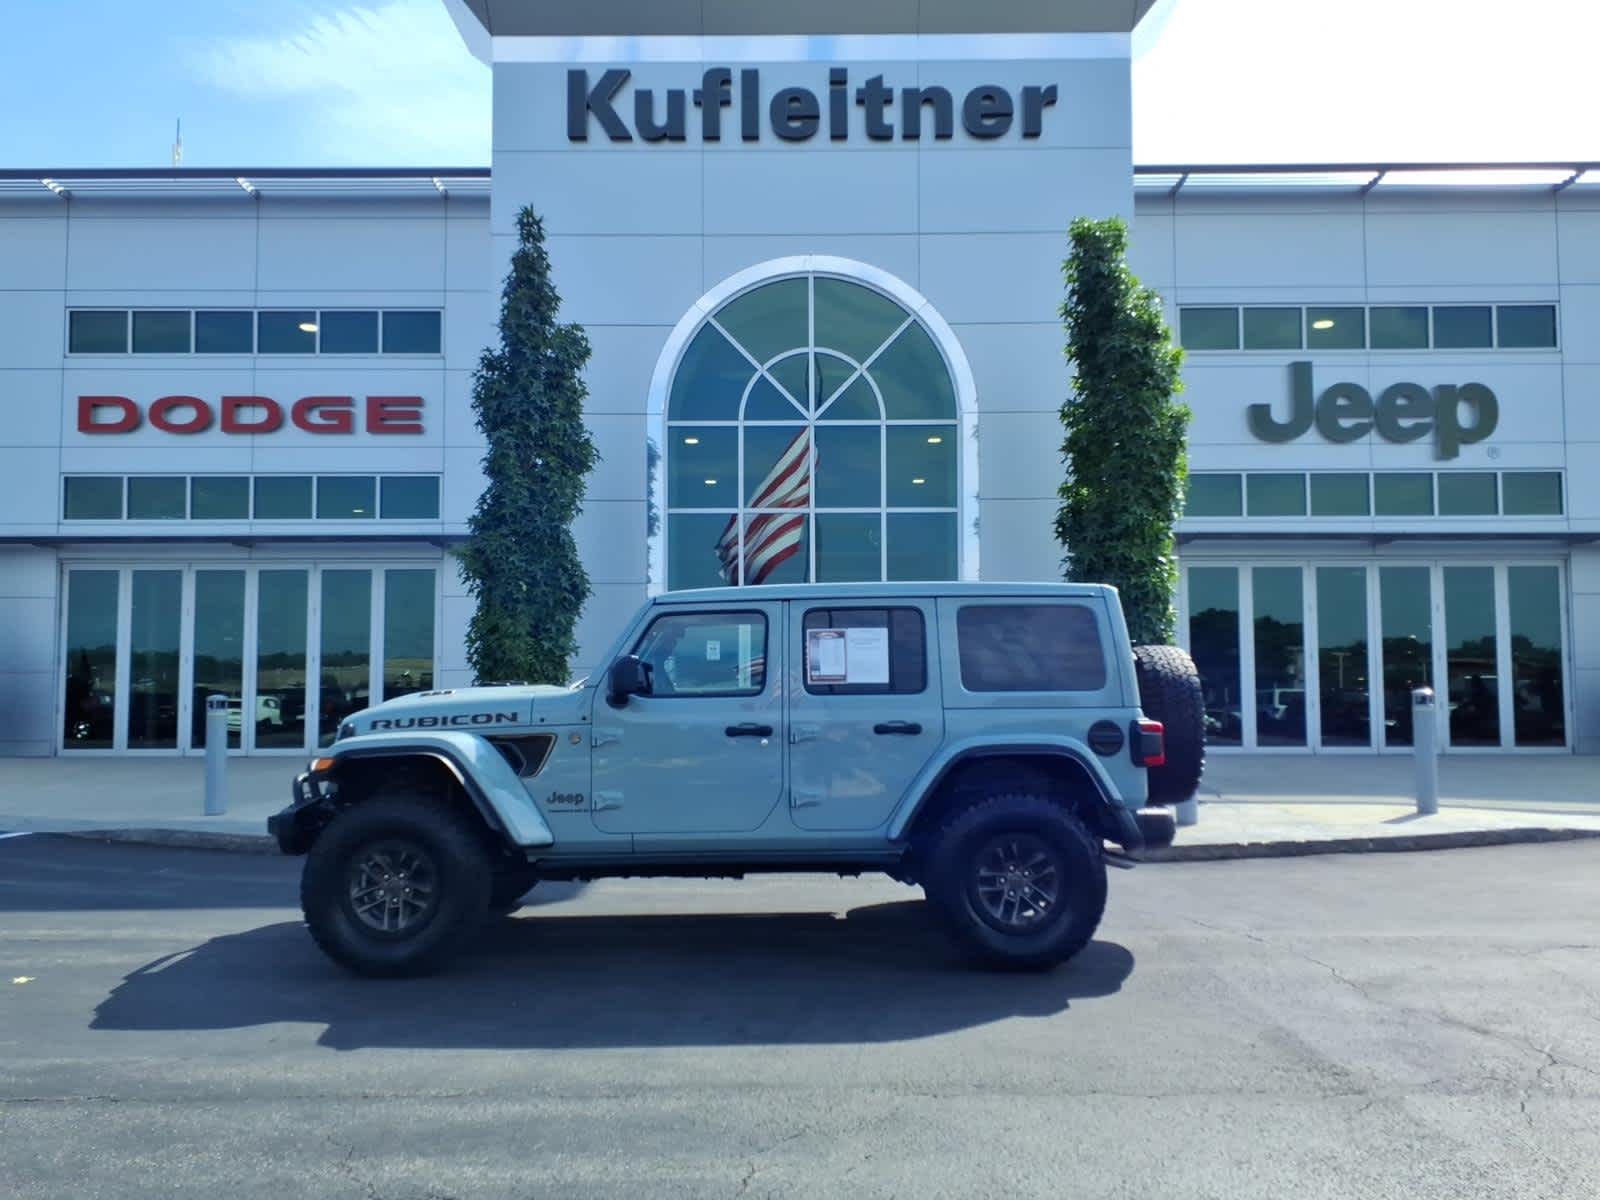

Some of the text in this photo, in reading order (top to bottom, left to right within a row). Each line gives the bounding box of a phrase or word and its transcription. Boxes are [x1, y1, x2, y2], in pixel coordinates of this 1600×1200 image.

[567, 68, 1058, 142] Kufleitner
[78, 396, 424, 434] DODGE
[1248, 361, 1499, 461] Jeep
[370, 712, 518, 730] RUBICON
[546, 791, 584, 806] Jeep
